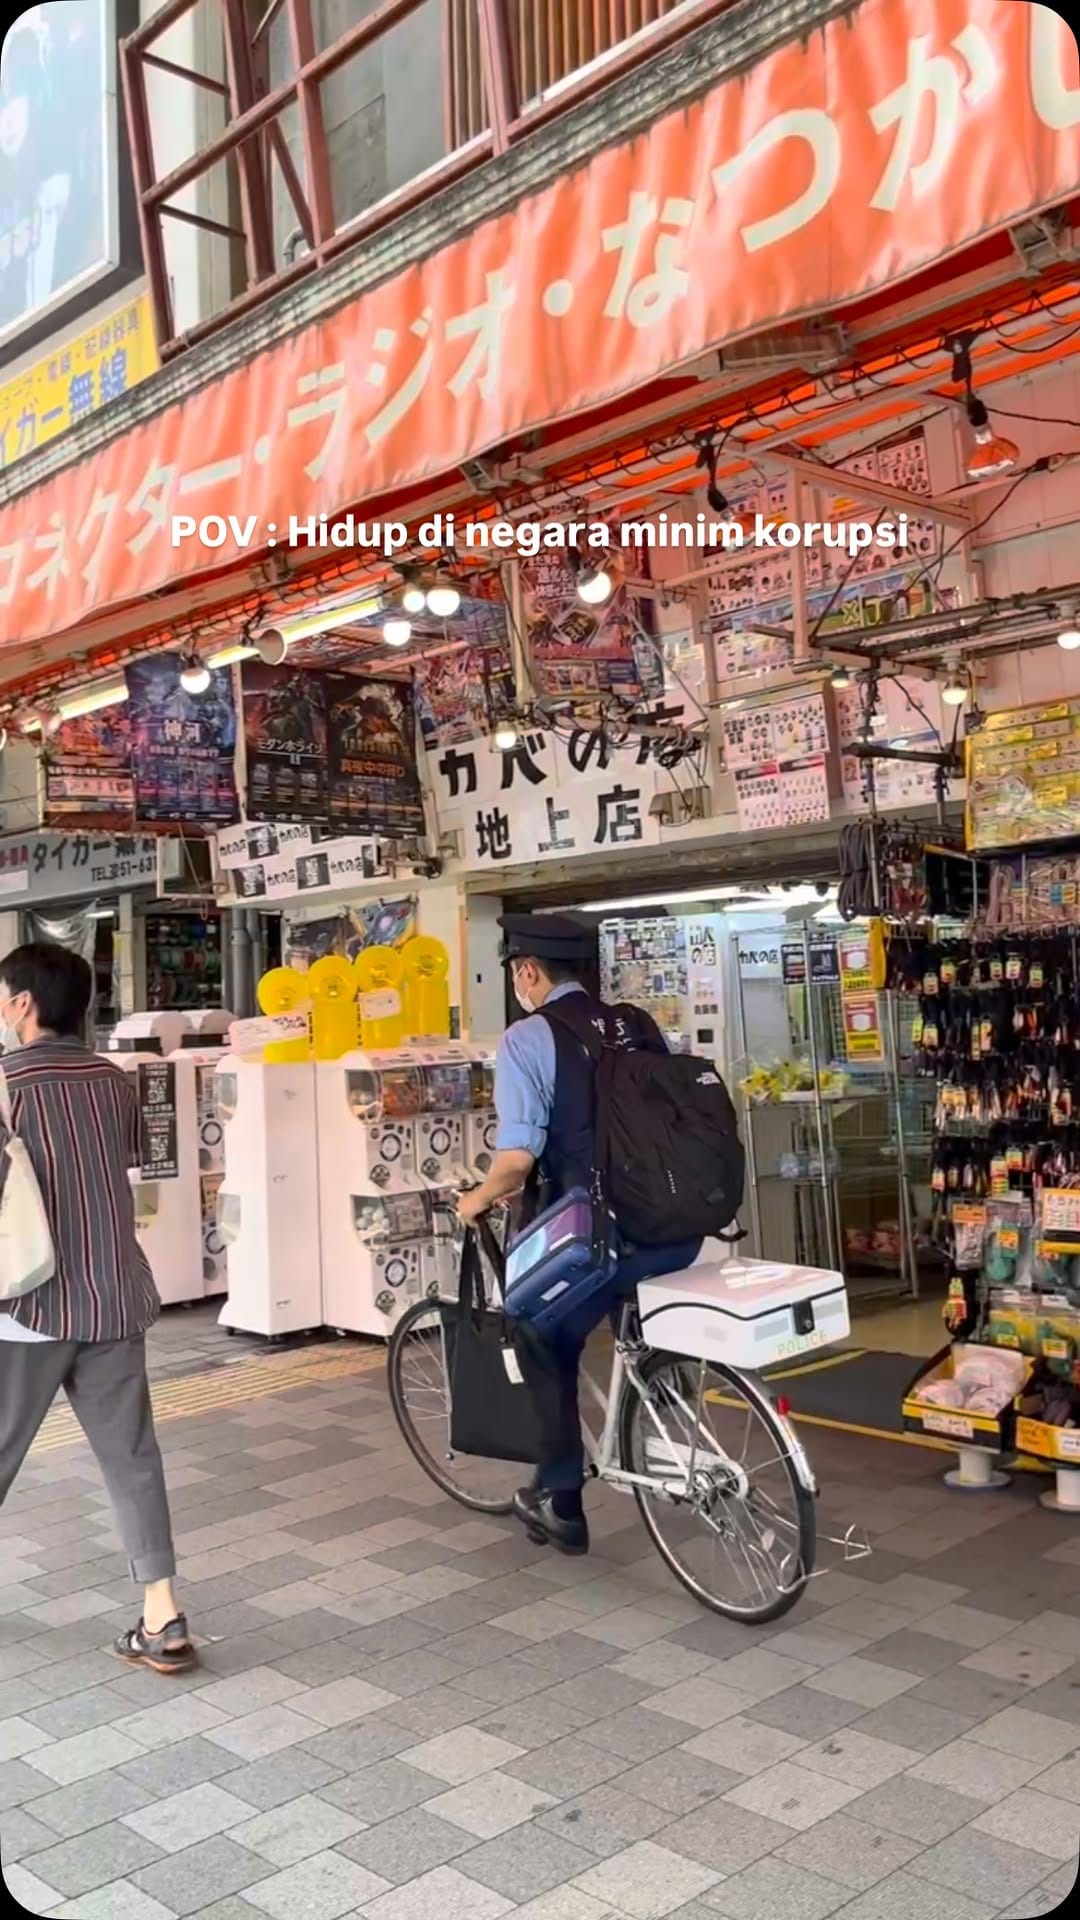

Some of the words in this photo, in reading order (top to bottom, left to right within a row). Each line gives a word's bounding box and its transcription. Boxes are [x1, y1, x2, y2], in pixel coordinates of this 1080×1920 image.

[475, 784, 643, 861] 地上店
[776, 1330, 827, 1356] POLICE
